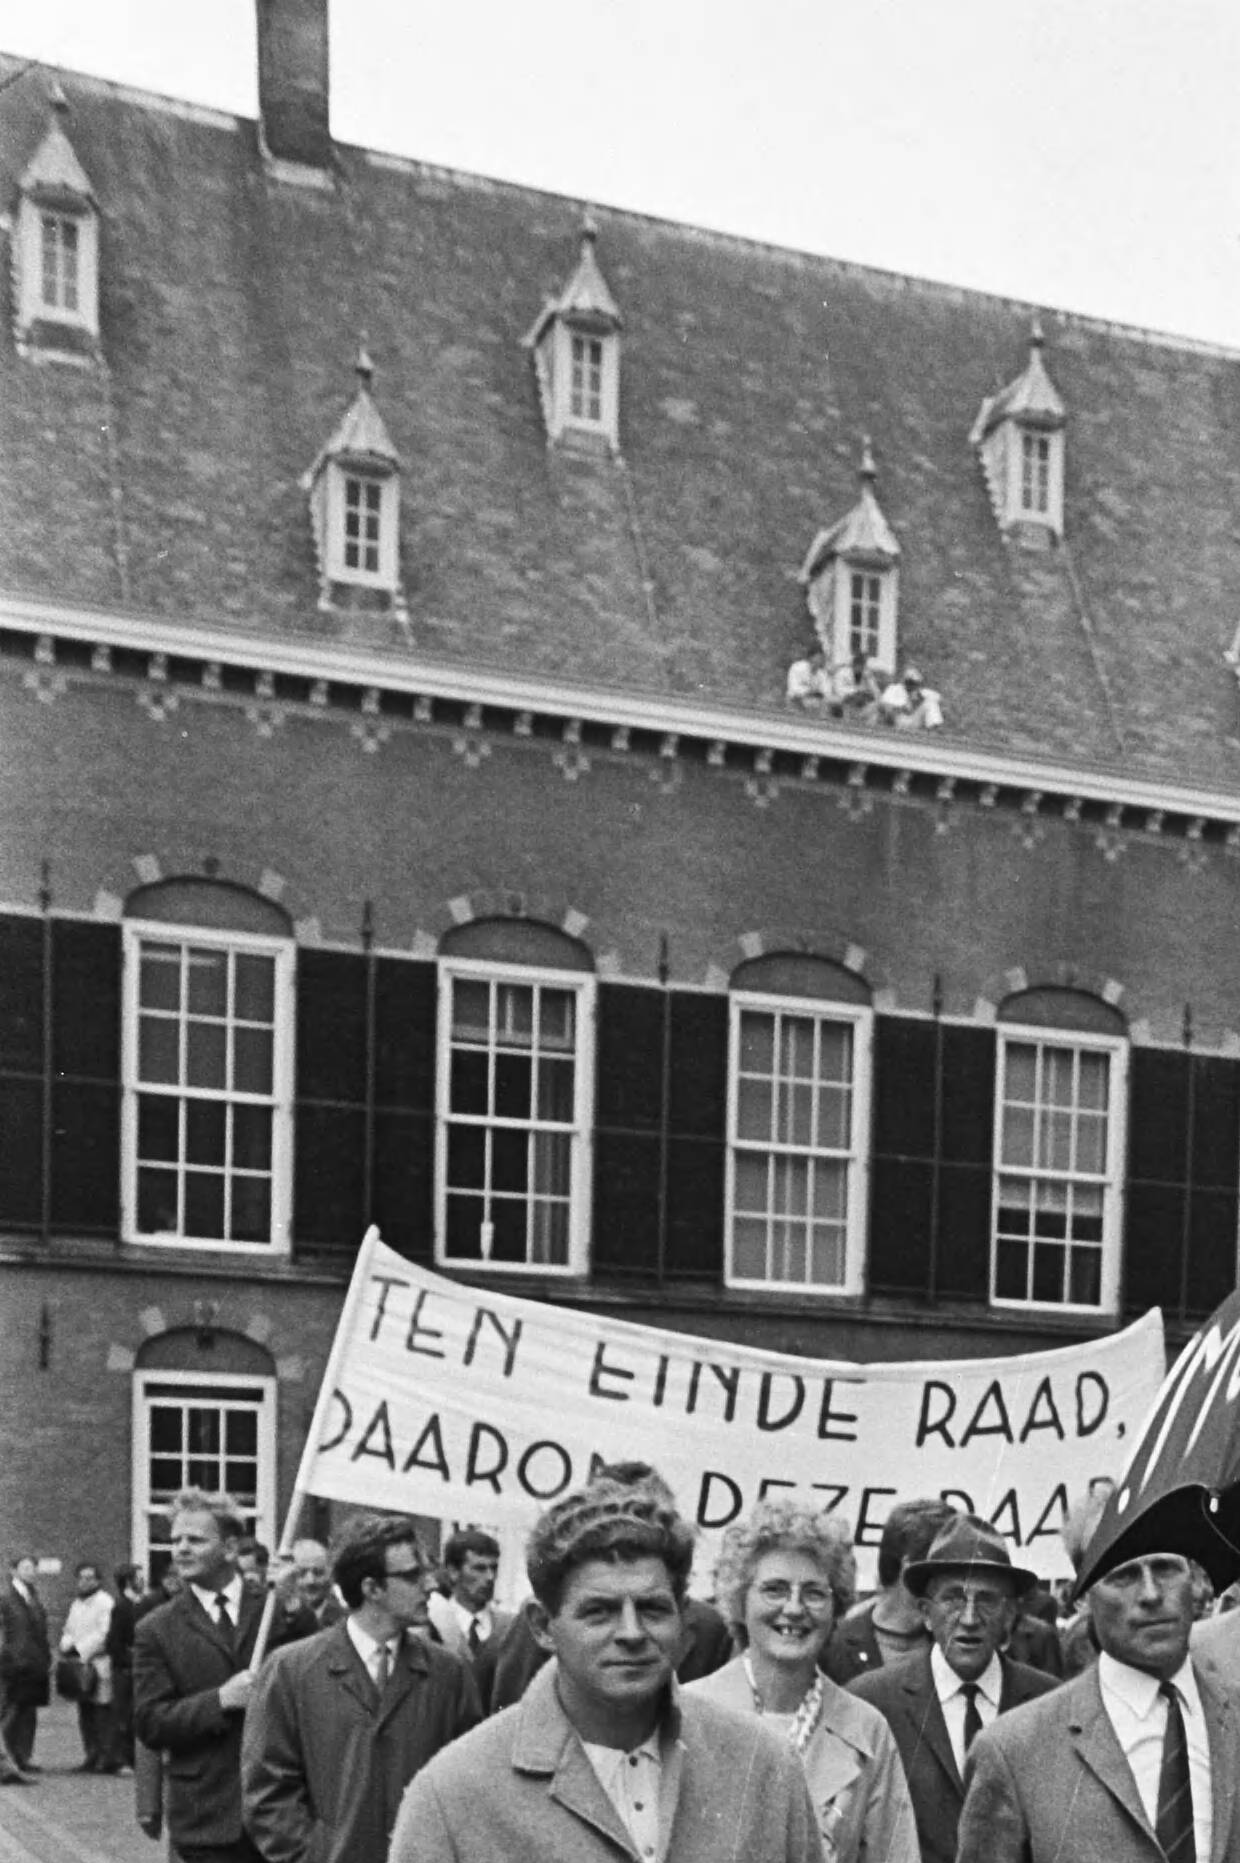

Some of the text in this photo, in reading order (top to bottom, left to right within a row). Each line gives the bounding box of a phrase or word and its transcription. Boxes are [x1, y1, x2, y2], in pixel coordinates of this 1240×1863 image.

[371, 1275, 1126, 1448] TEN EINDE RAAD,
[317, 1388, 604, 1501] DAARO
